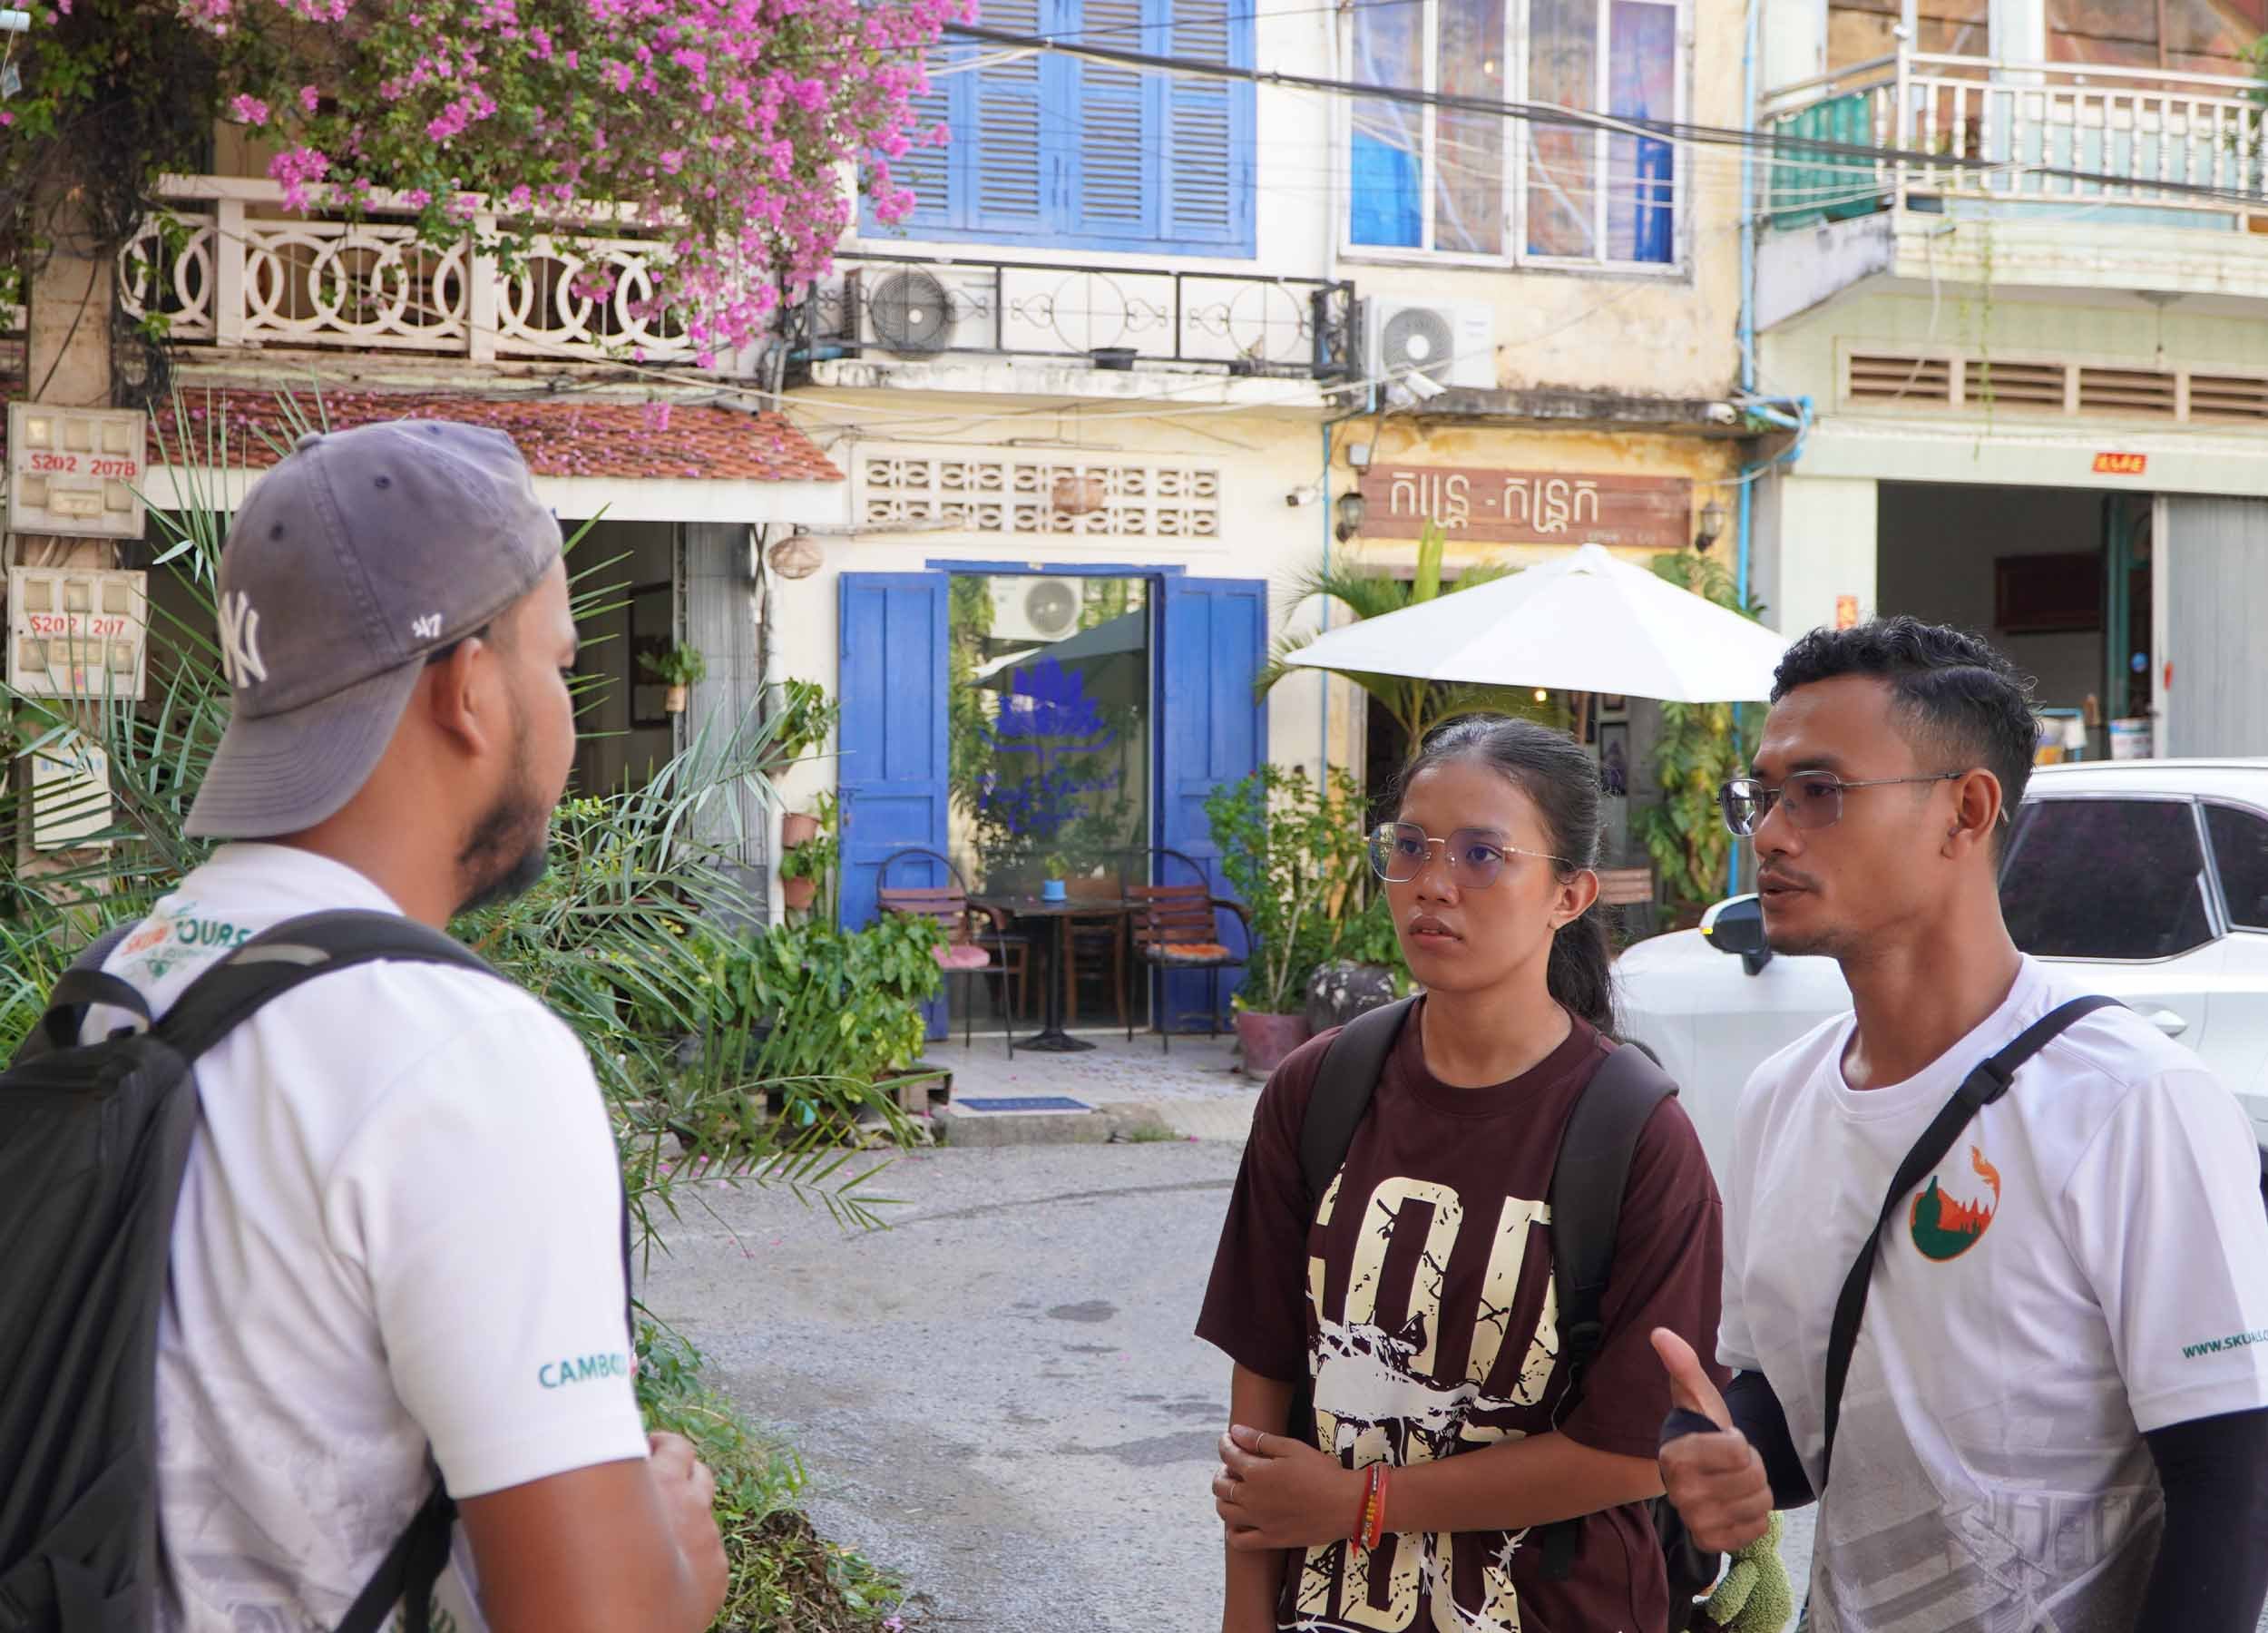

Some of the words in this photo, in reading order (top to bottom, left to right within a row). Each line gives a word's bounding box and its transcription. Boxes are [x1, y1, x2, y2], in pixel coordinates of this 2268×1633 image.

[32, 454, 78, 473] S202
[91, 460, 136, 478] 207B
[93, 619, 126, 636] 207
